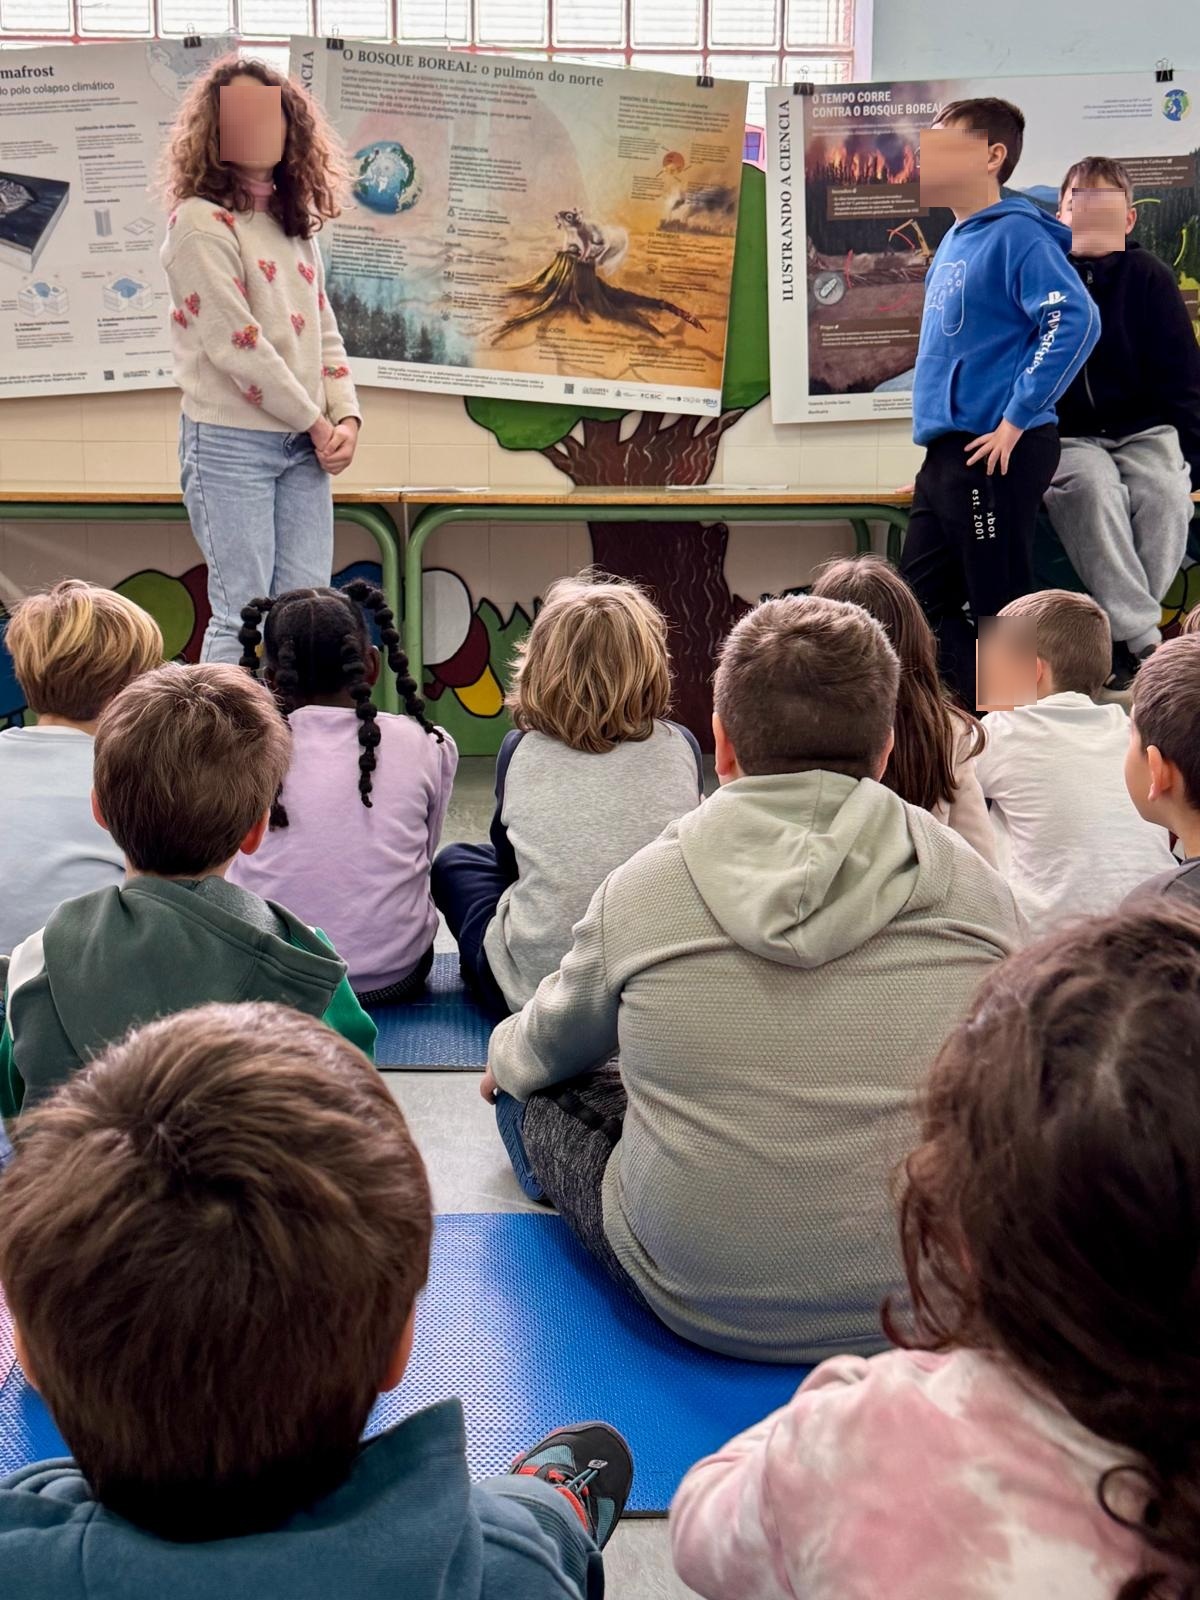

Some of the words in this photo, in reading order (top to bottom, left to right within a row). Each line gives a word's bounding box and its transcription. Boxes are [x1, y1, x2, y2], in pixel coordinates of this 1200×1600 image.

[0, 65, 54, 79] mafrost
[343, 49, 353, 61] O
[358, 50, 414, 67] BOSQUE
[418, 56, 477, 73] BOREAL:
[481, 65, 489, 75] o
[494, 66, 543, 81] pulmón
[548, 70, 564, 82] do
[569, 74, 604, 87] norte
[10, 84, 31, 96] polo
[33, 83, 70, 95] colapso
[71, 81, 115, 92] climático
[812, 94, 819, 104] O
[822, 92, 855, 104] TEMPO
[857, 91, 891, 102] CORRE
[812, 106, 852, 118] CONTRA
[854, 106, 861, 116] O
[863, 104, 904, 117] BOSQUE
[778, 100, 791, 172] CIENCIA
[781, 176, 792, 186] A
[781, 191, 794, 301] ILUSTRANDO
[972, 489, 980, 509] est.
[973, 514, 985, 540] 2001
[986, 511, 996, 538] xbox
